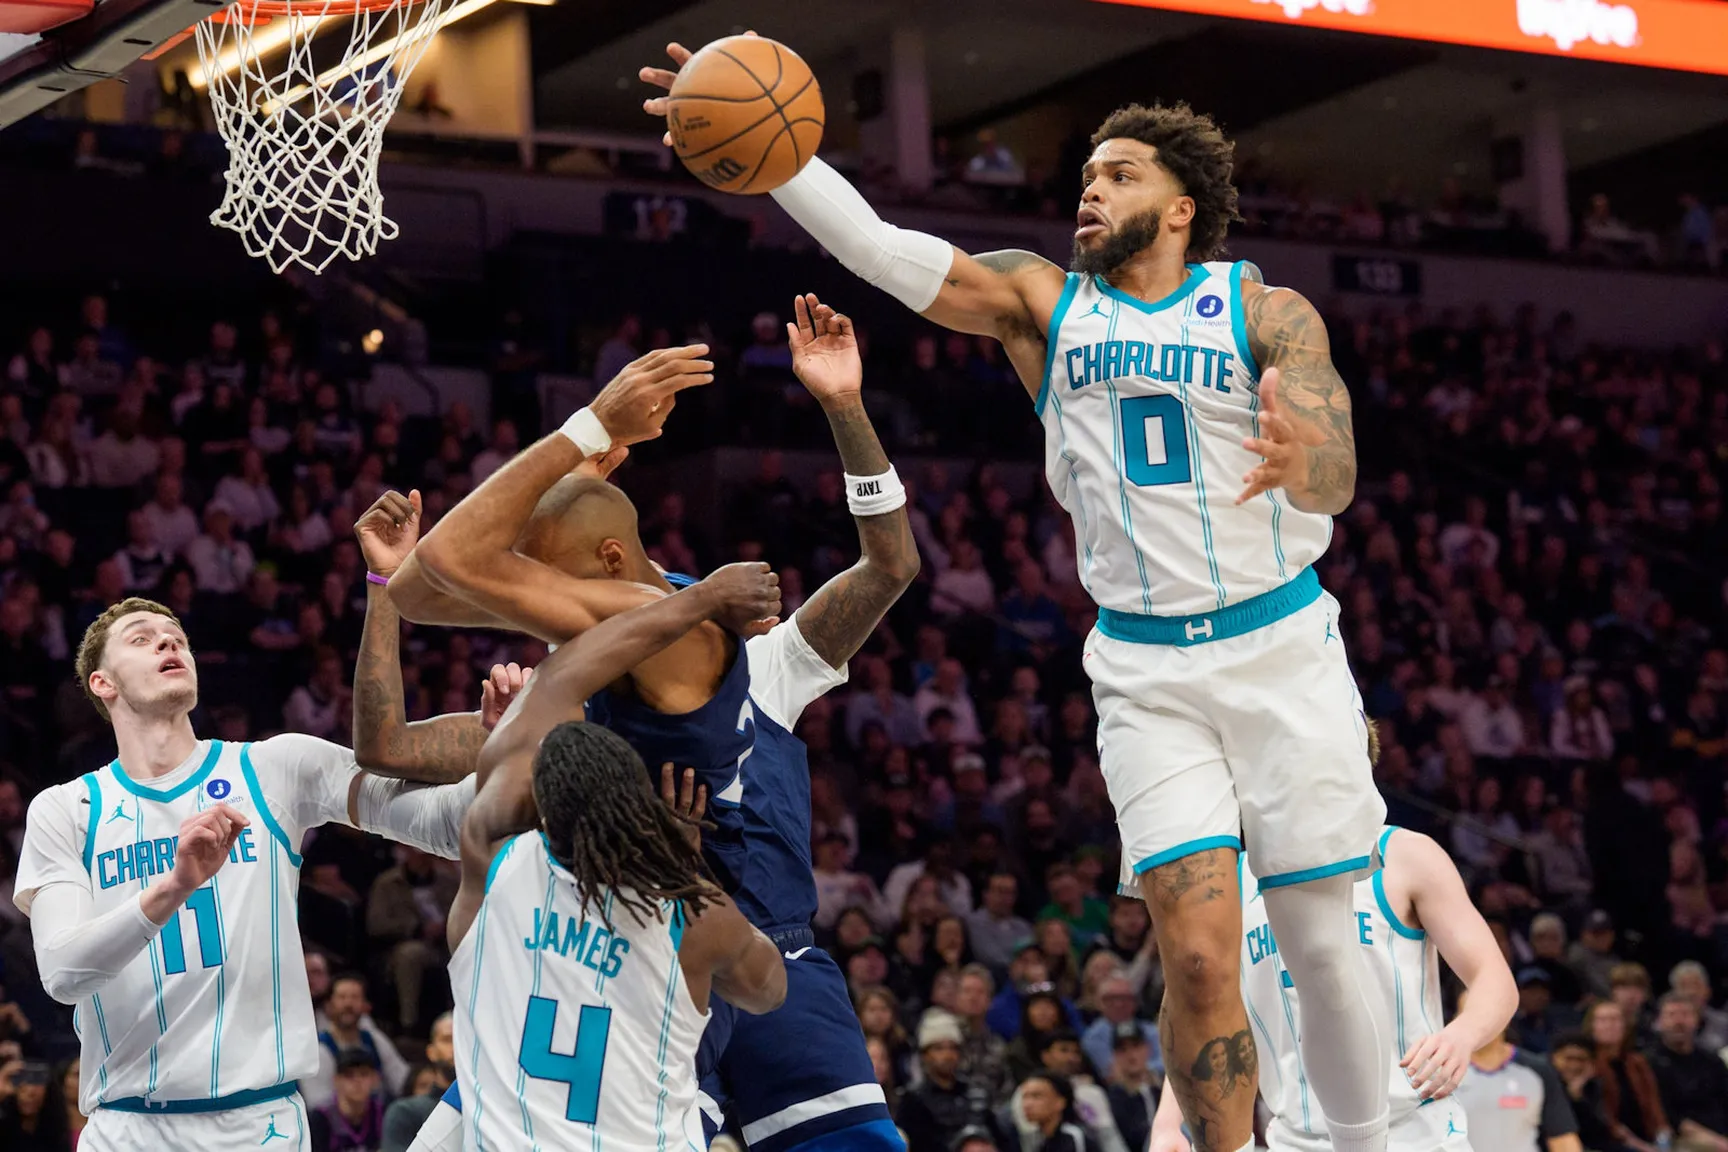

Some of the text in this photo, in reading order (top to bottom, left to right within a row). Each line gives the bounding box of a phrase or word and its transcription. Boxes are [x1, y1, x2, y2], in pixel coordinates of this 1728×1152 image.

[1065, 340, 1235, 394] CHARLOTTE
[1120, 393, 1192, 486] 0
[856, 480, 883, 497] TAYP
[160, 886, 225, 975] 11
[524, 907, 631, 980] JAMES
[518, 995, 612, 1125] 4
